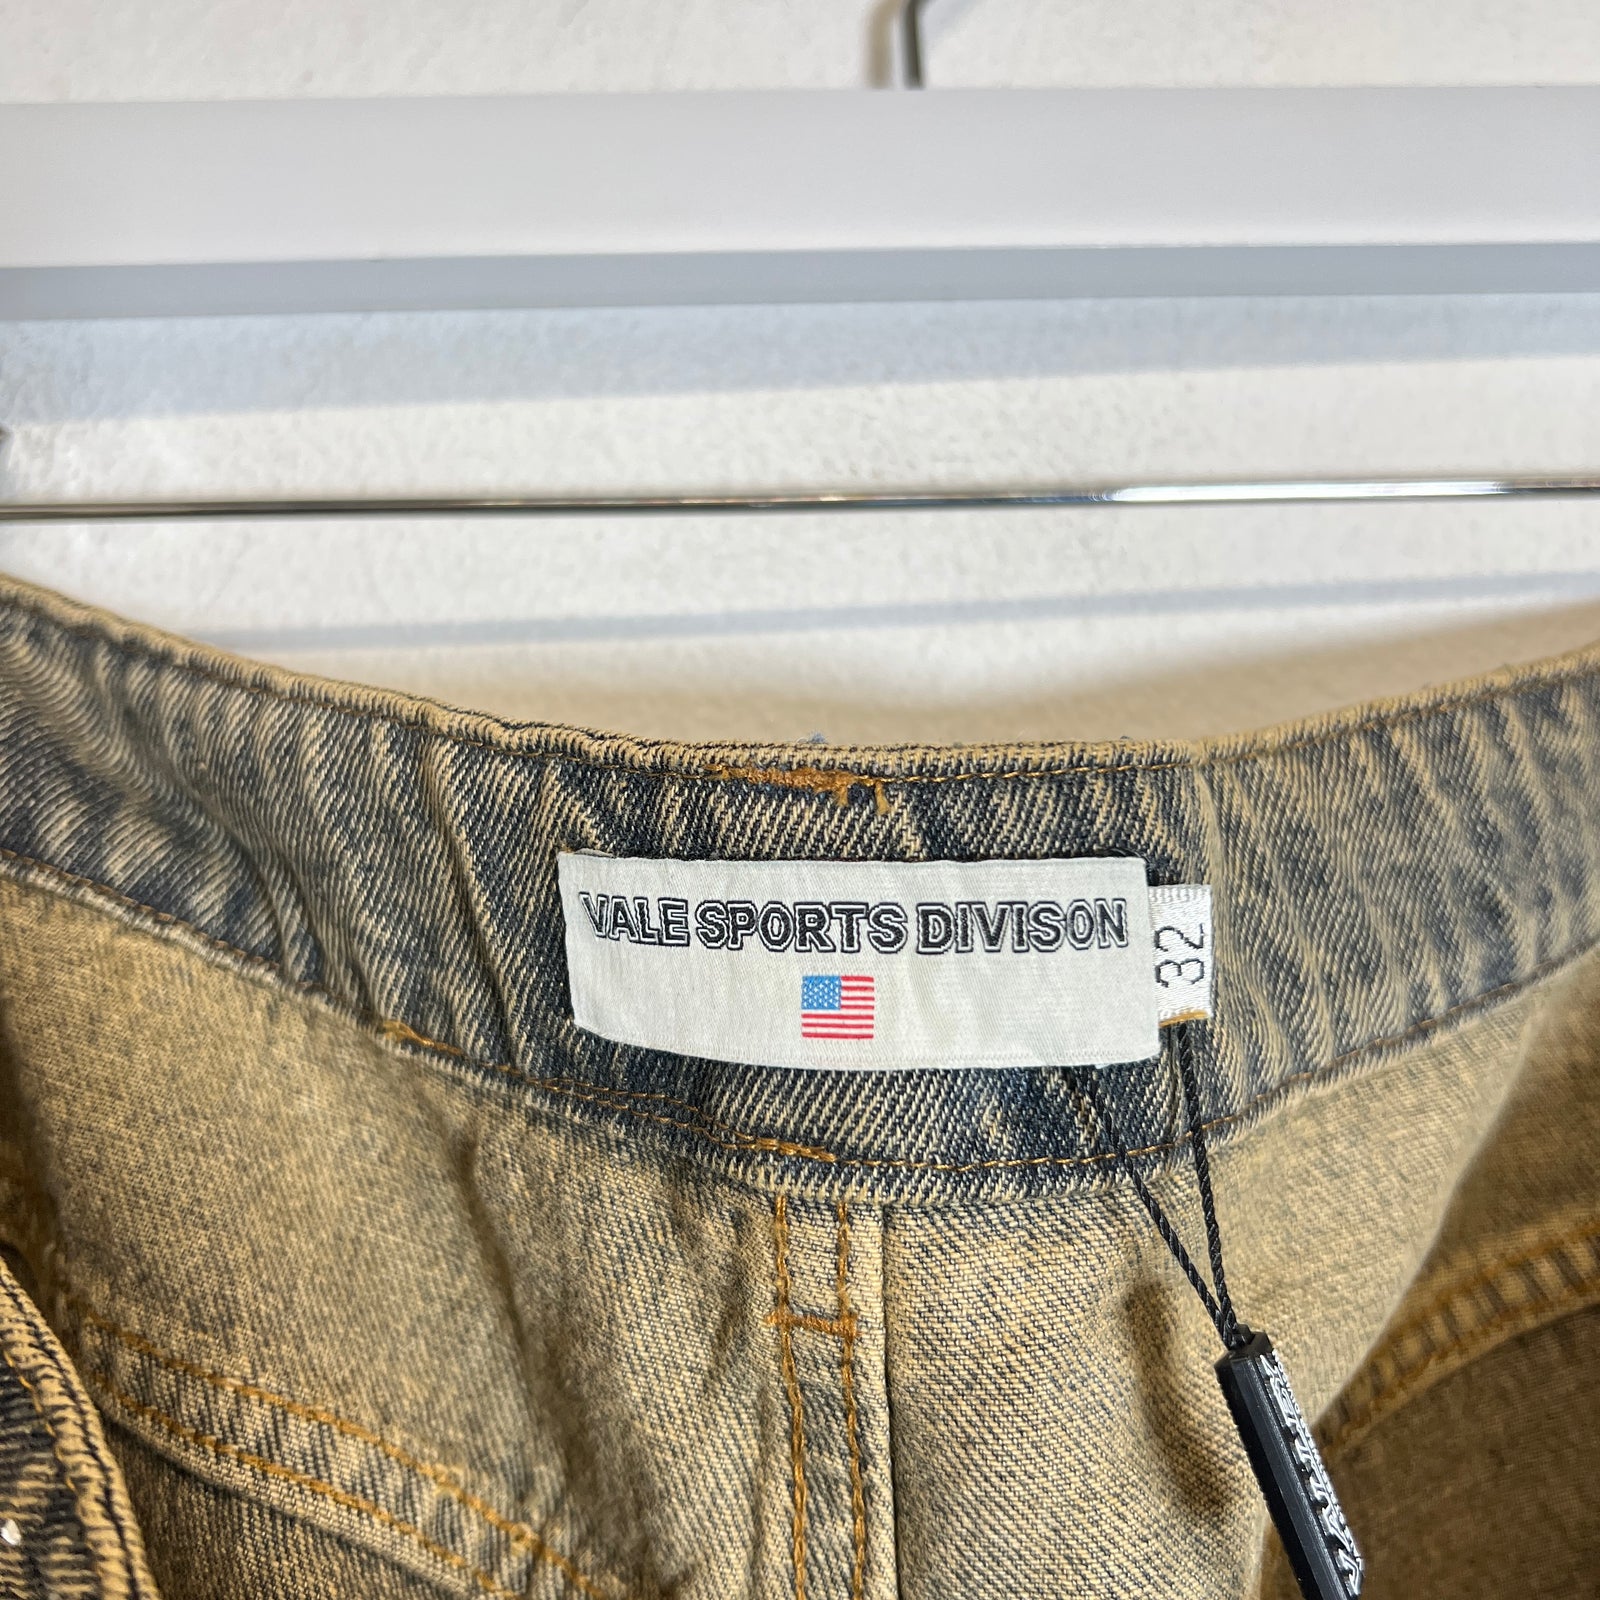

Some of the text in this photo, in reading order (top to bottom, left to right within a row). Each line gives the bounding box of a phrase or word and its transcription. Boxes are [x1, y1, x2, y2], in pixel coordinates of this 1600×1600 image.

[578, 891, 1130, 955] VALE SPORTS DIVISON
[1153, 923, 1205, 988] 32
